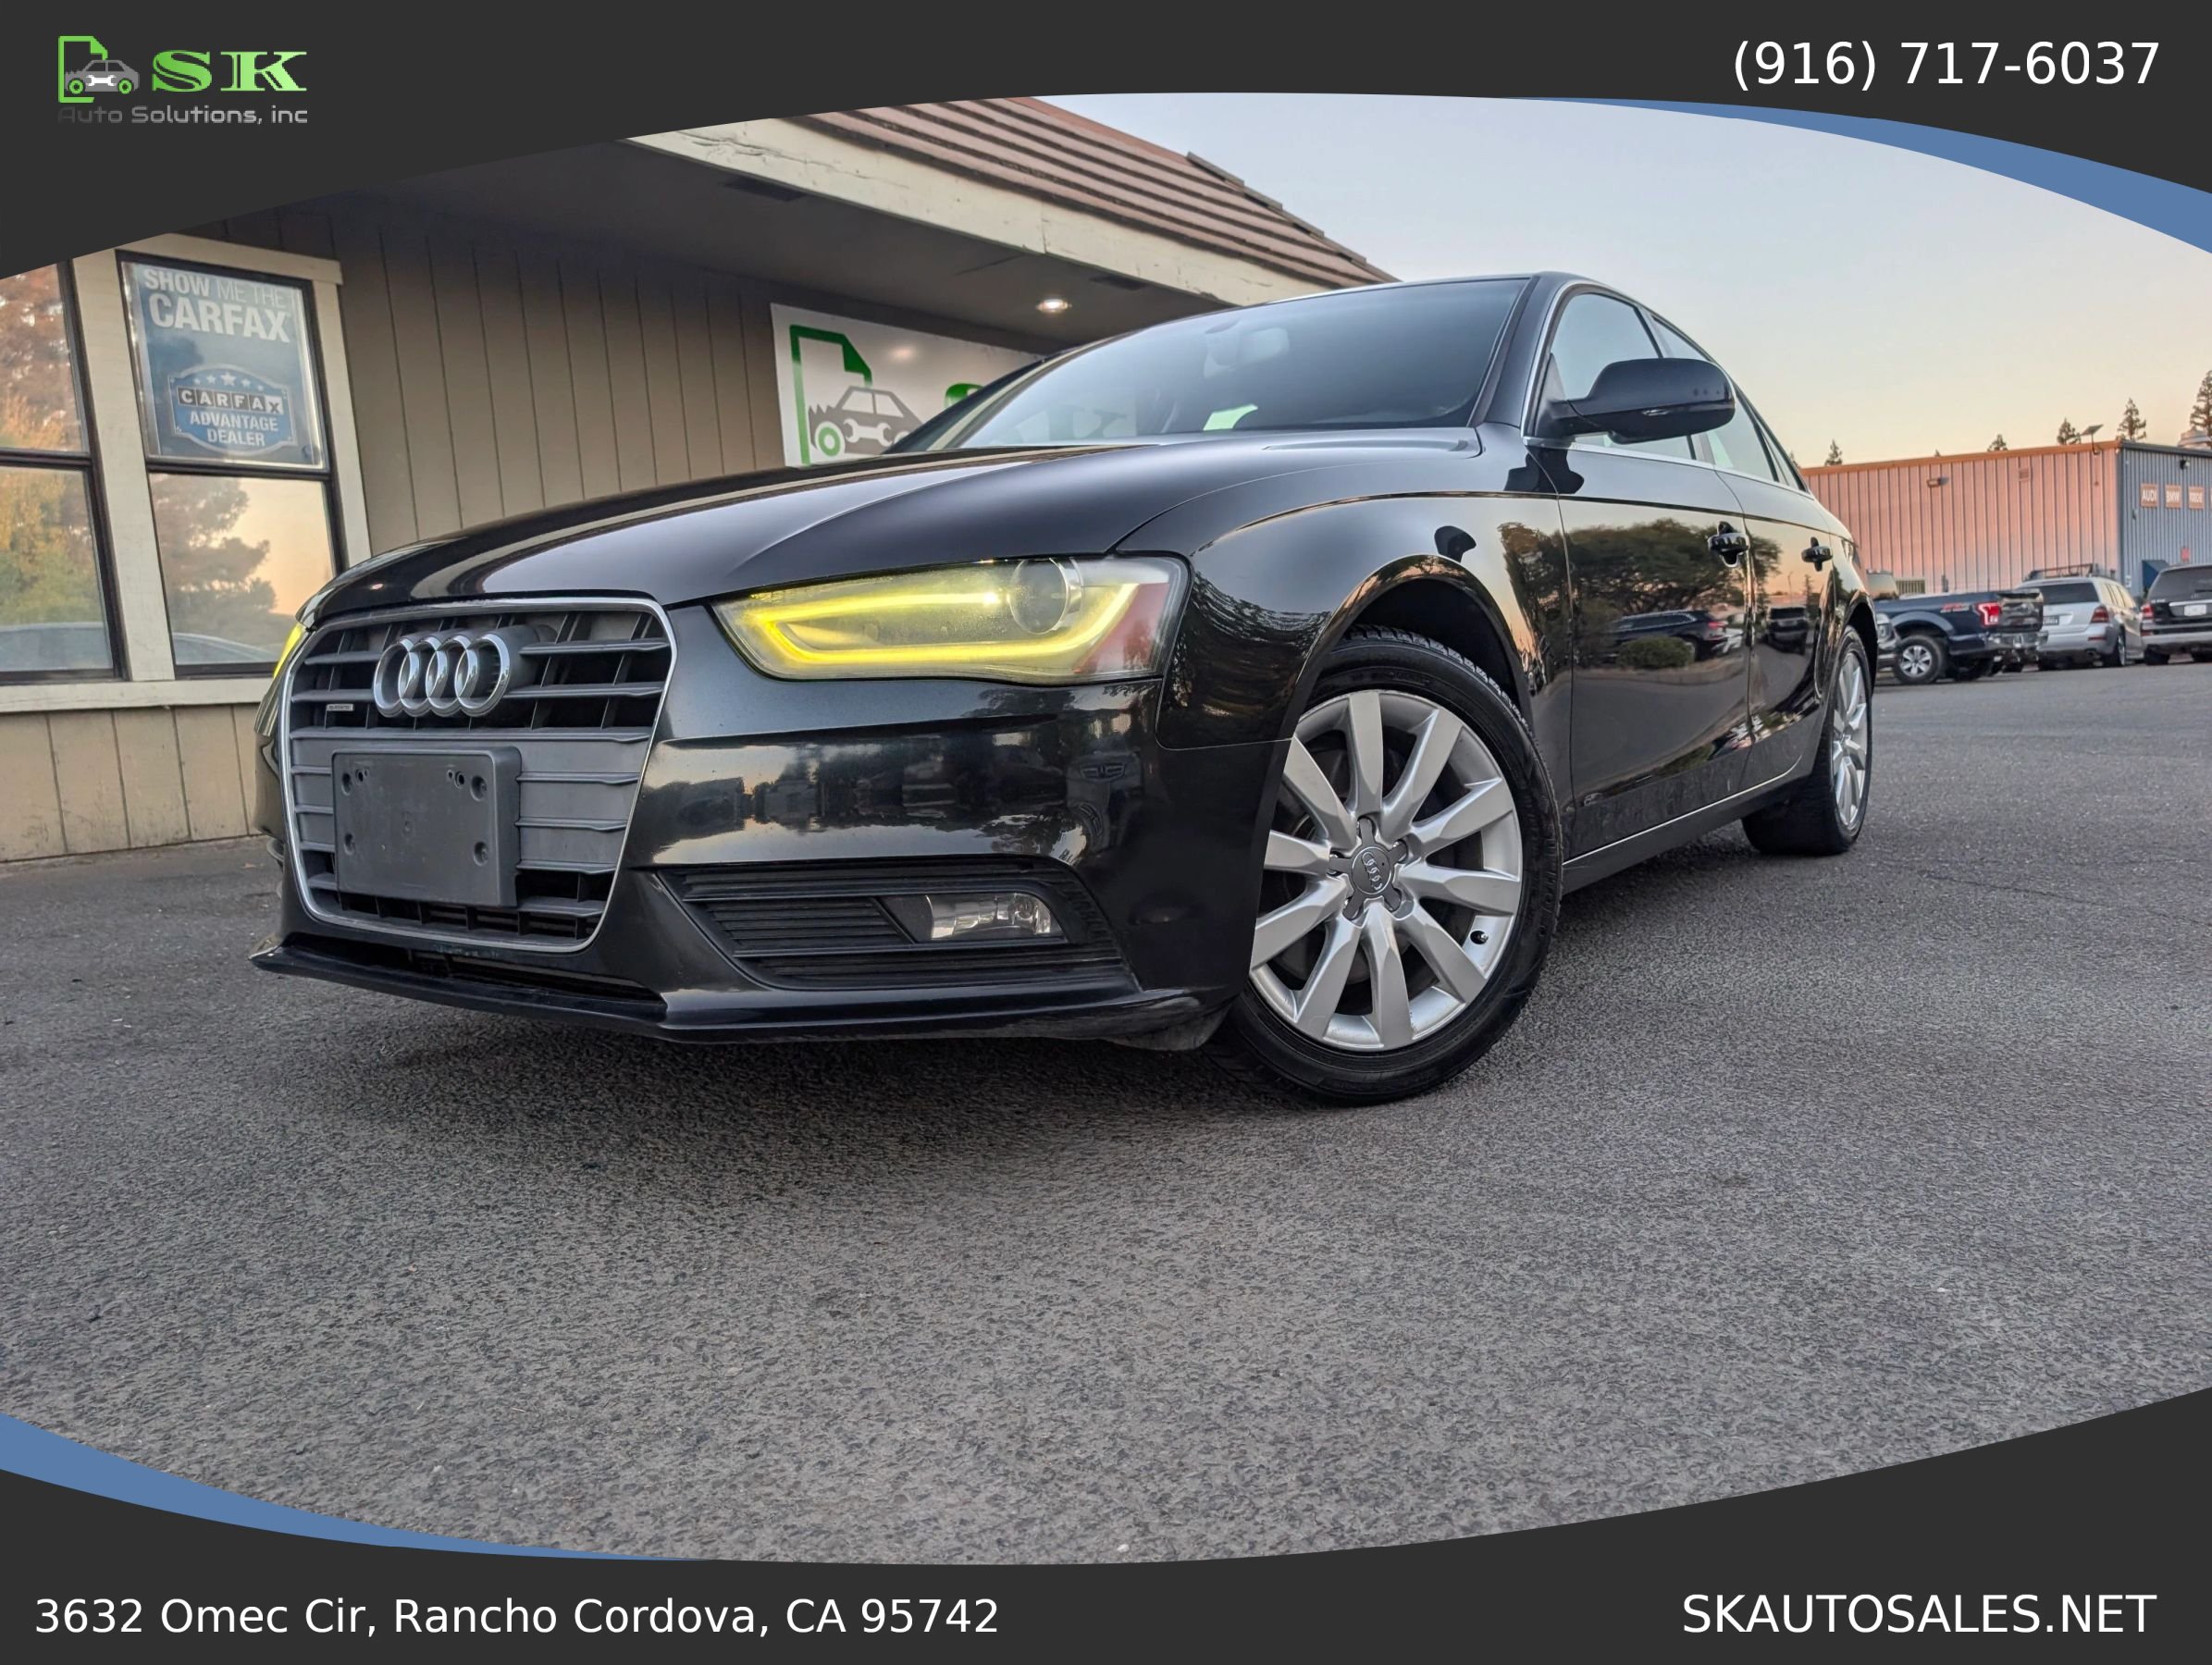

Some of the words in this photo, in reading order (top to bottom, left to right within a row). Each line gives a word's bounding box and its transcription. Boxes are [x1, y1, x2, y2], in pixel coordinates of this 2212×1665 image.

[143, 268, 210, 297] SHOW
[216, 279, 246, 303] ME
[250, 284, 286, 308] THE
[148, 292, 290, 343] CARFAX
[180, 388, 281, 413] CARFAX
[190, 411, 279, 431] ADVANTAGE
[207, 428, 266, 447] DEALER
[2141, 487, 2157, 502] AUDI
